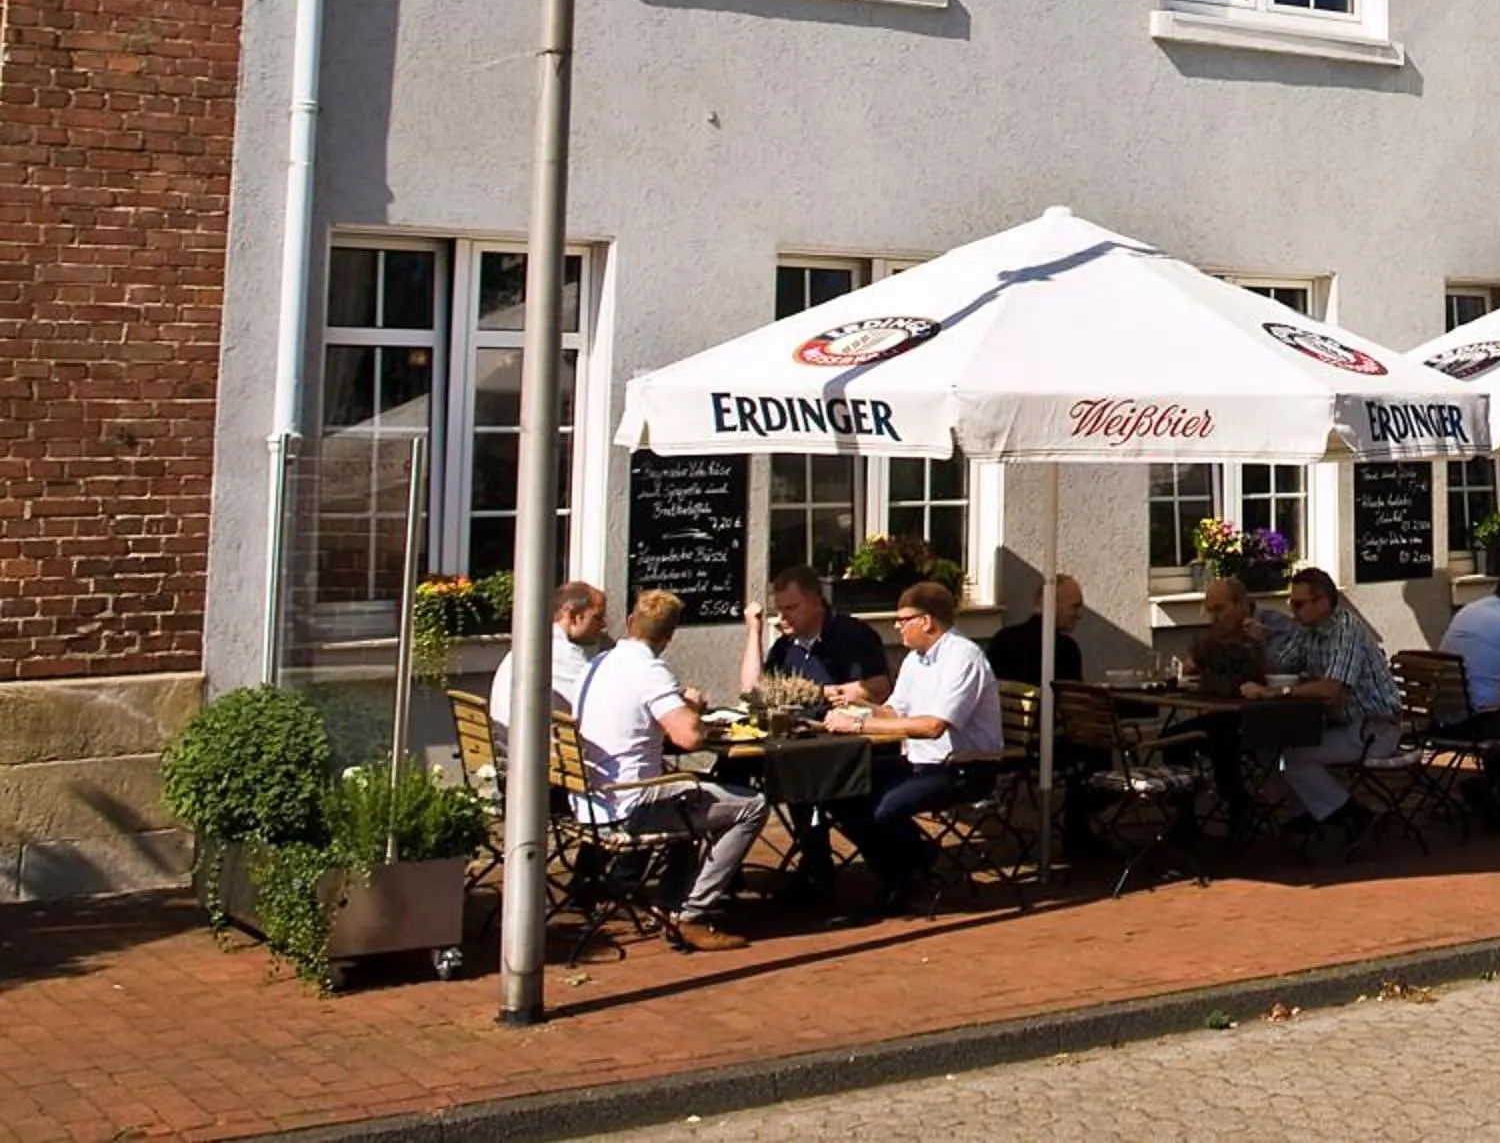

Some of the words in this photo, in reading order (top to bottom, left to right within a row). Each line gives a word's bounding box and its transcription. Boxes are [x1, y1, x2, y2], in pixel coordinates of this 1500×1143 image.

[711, 392, 902, 442] ERDINGER
[1069, 398, 1215, 446] Weißbier
[1365, 400, 1469, 444] ERDINGER
